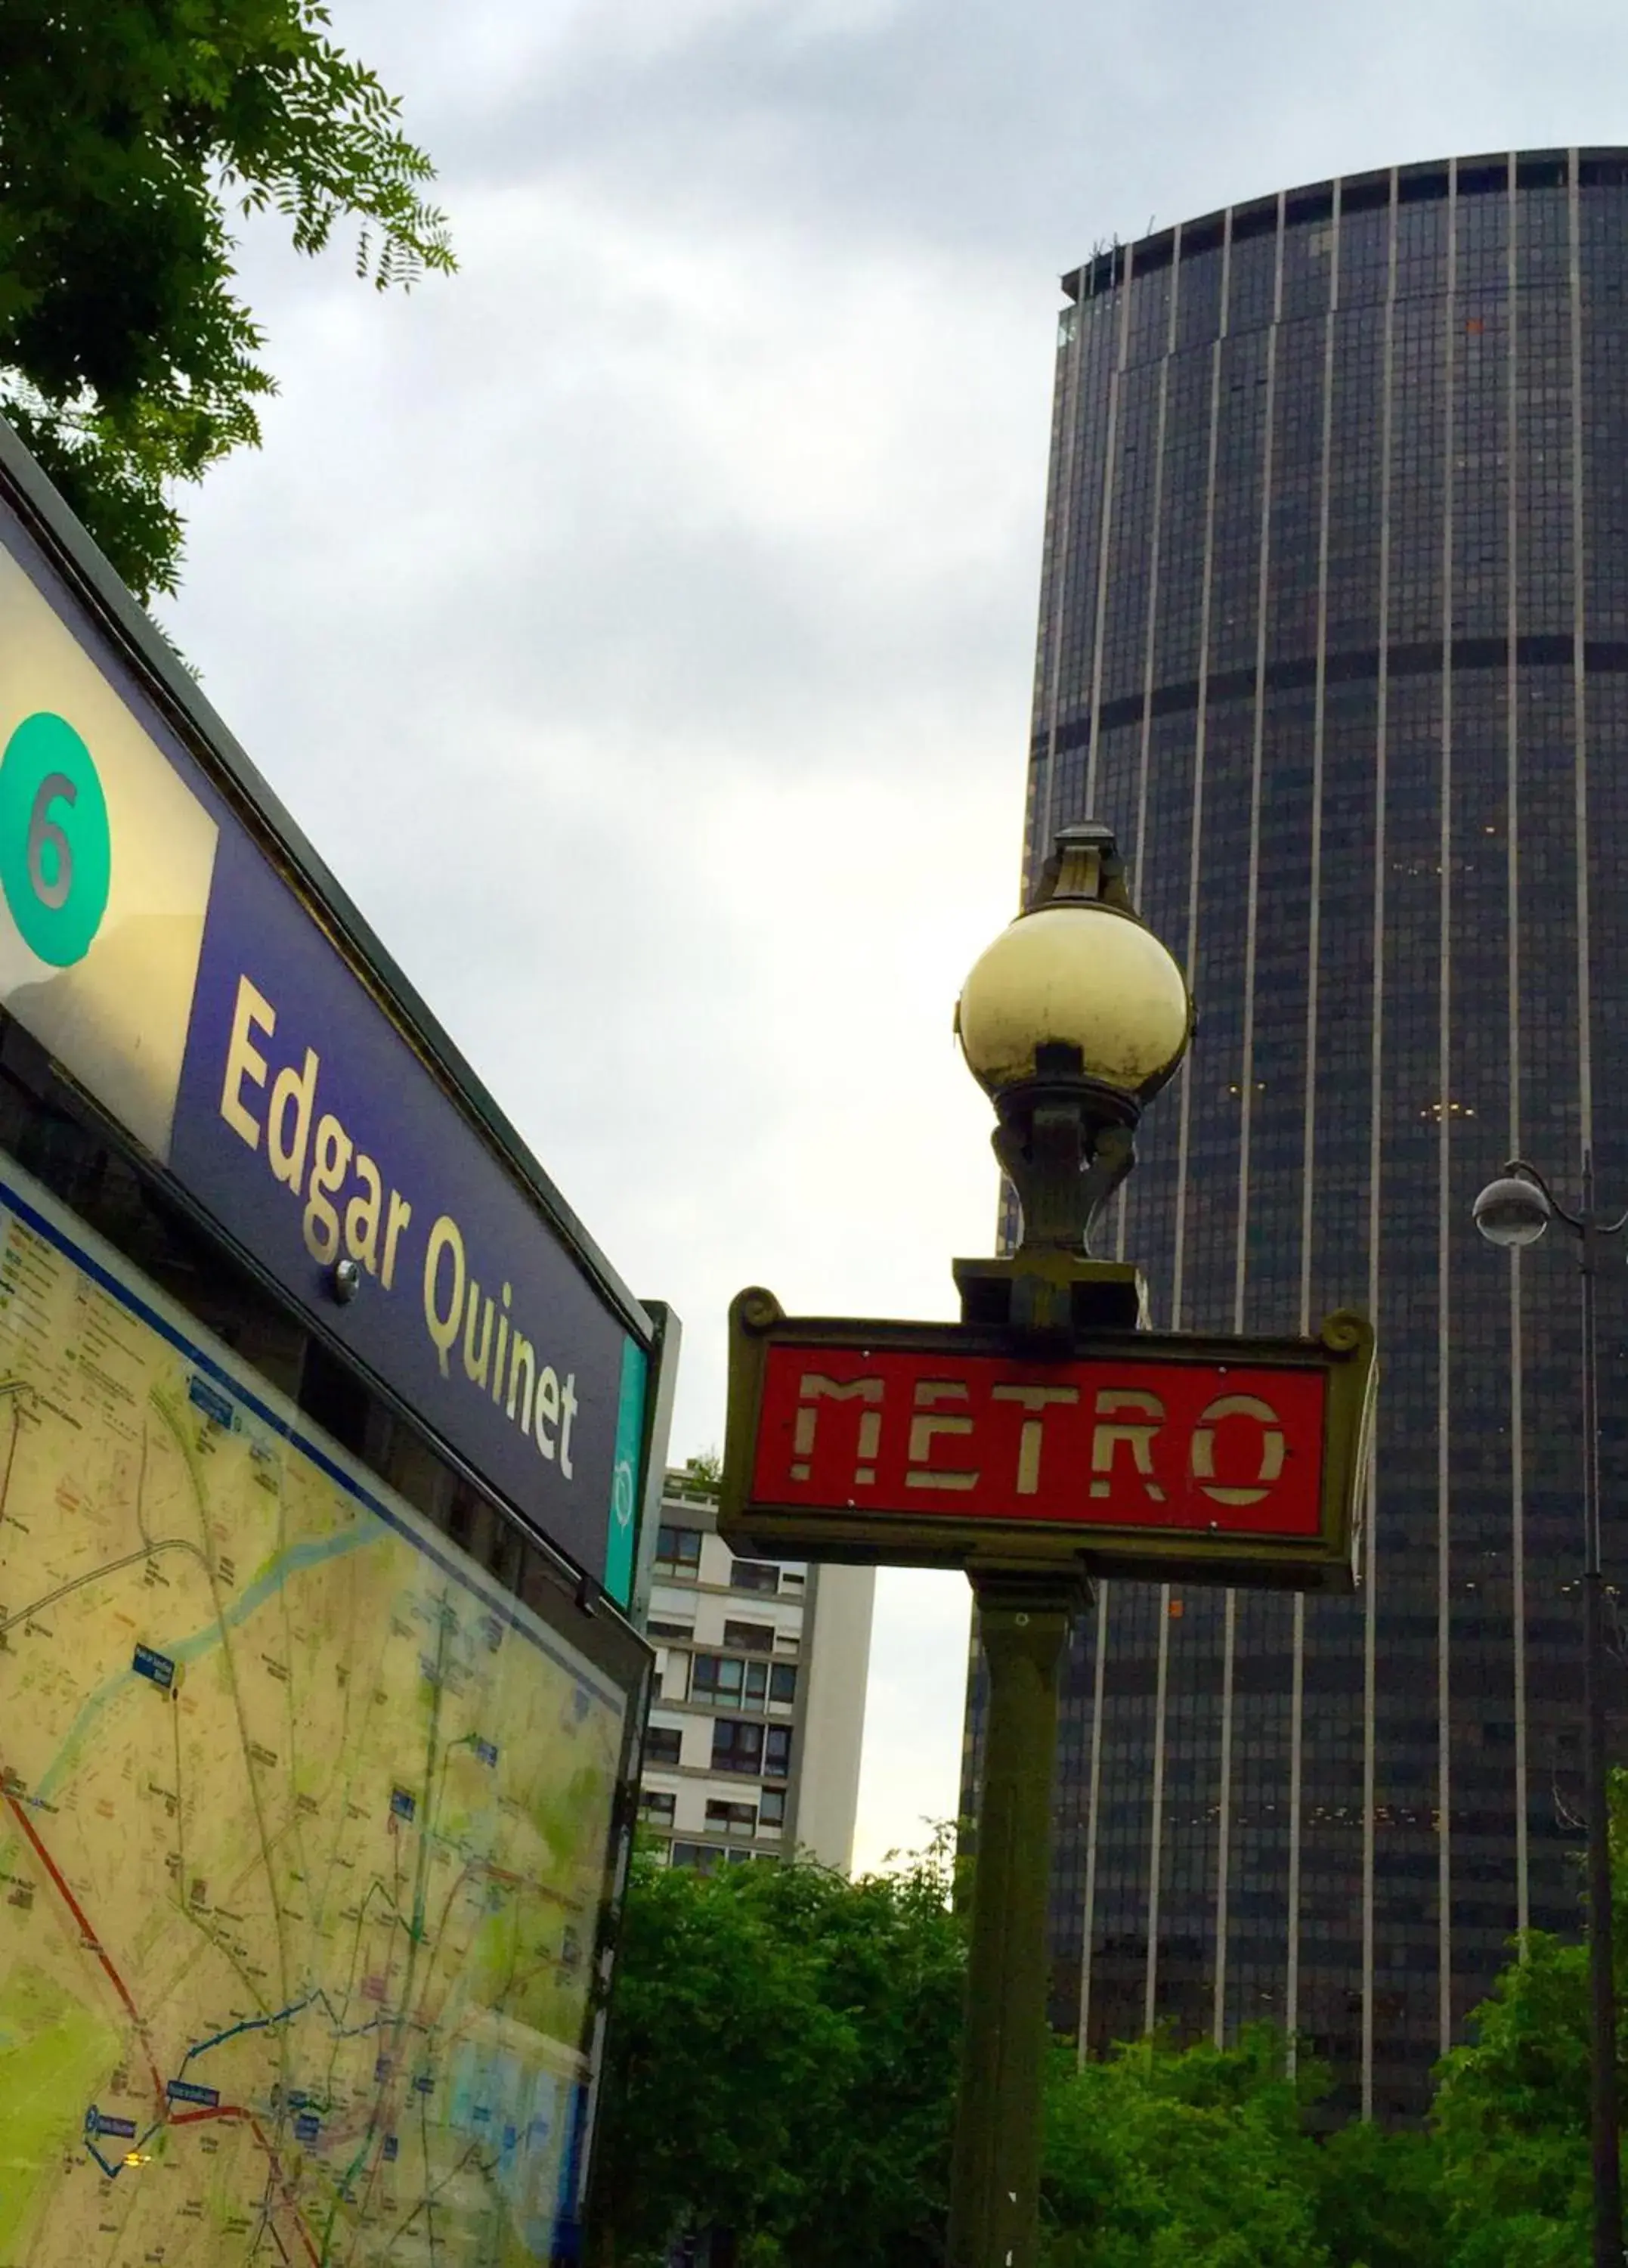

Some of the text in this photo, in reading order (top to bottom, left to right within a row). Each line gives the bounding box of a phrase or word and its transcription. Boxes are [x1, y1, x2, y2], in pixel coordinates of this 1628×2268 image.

[26, 773, 77, 909] 6
[220, 973, 578, 1480] Edgar Quinet
[790, 1373, 1286, 1506] METRO
